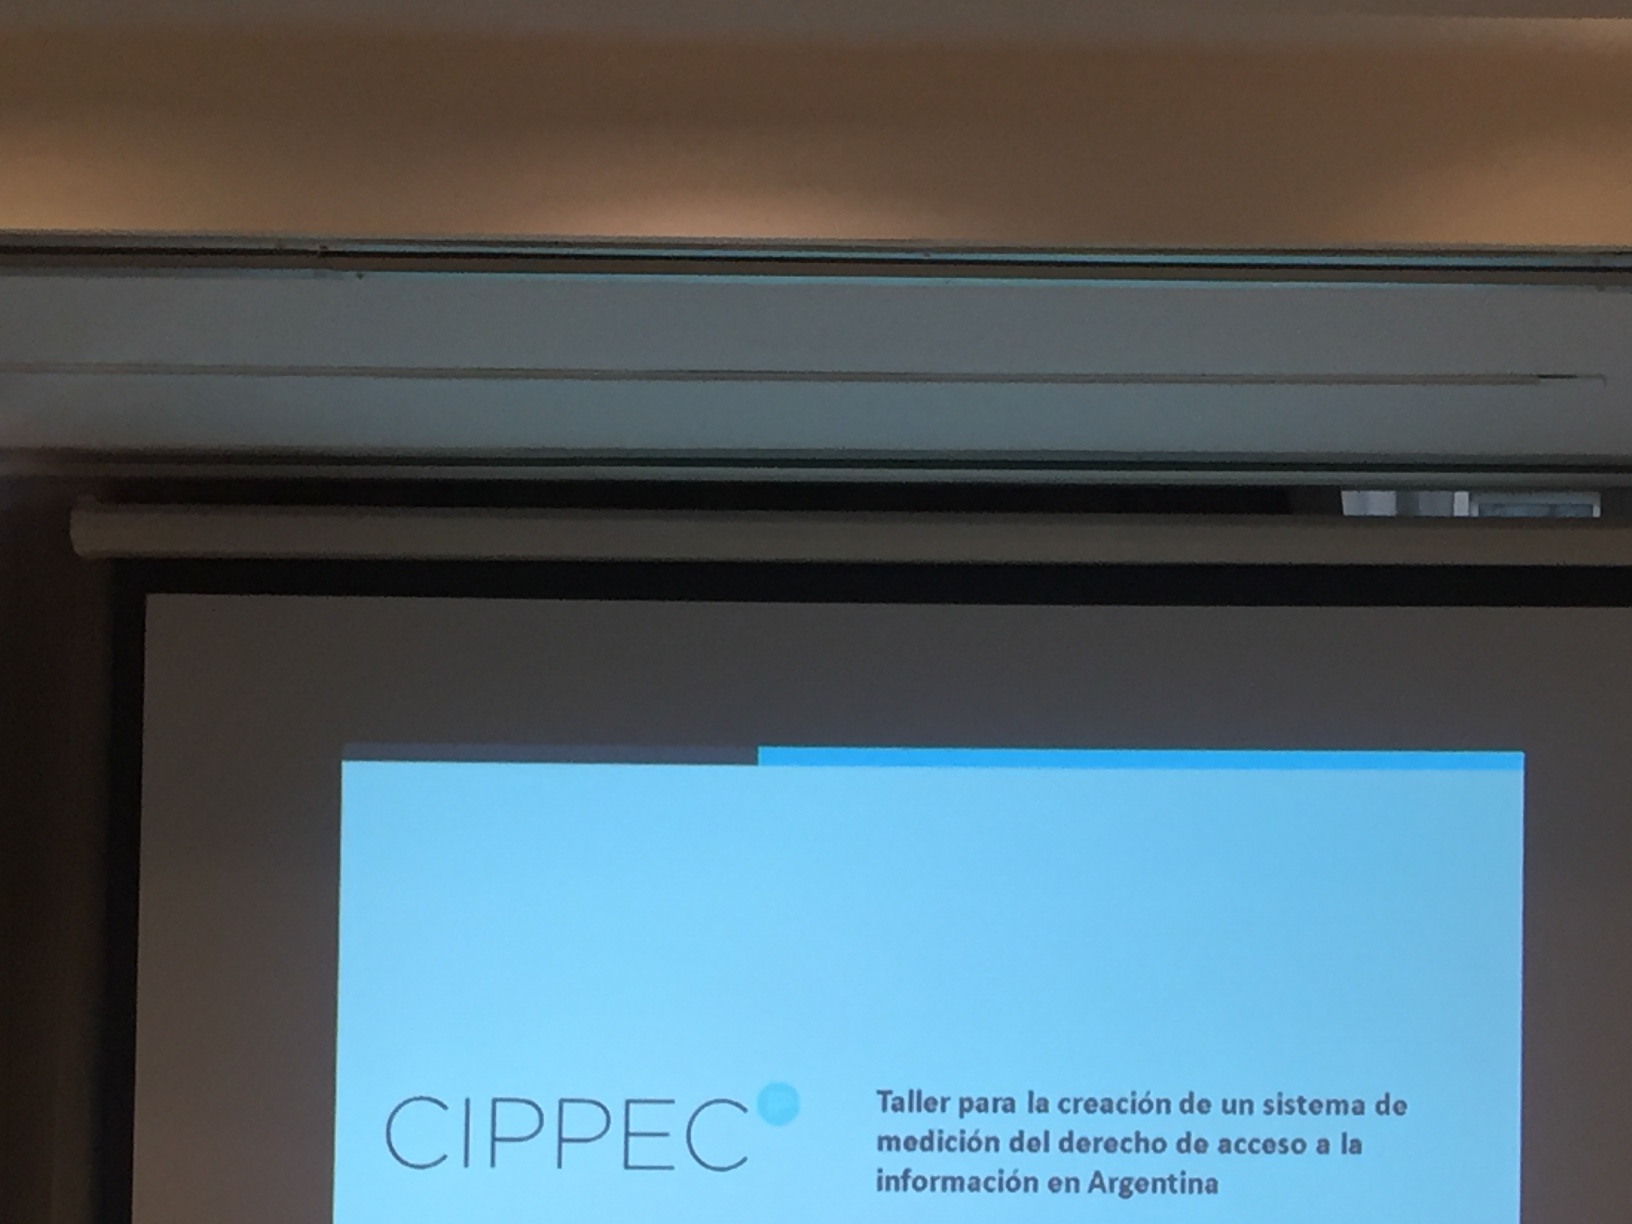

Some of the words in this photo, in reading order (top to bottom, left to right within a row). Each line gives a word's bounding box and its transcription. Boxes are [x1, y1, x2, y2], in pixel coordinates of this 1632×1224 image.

[875, 1087, 952, 1114] Taller
[958, 1096, 1016, 1120] para
[1027, 1089, 1050, 1115] la
[1057, 1089, 1172, 1116] creación
[1178, 1089, 1213, 1116] de
[1221, 1097, 1255, 1117] un
[1262, 1090, 1366, 1117] sistema
[1374, 1090, 1409, 1117] de
[386, 1096, 749, 1171] CIPPEC
[876, 1128, 1001, 1154] medición
[1008, 1129, 1051, 1154] del
[1058, 1129, 1168, 1155] derecho
[1175, 1130, 1210, 1155] de
[1216, 1136, 1308, 1156] acceso
[1315, 1137, 1331, 1156] a
[1341, 1131, 1363, 1156] la
[876, 1167, 1040, 1194] información
[1047, 1176, 1081, 1195] en
[1086, 1168, 1219, 1200] Argentina
